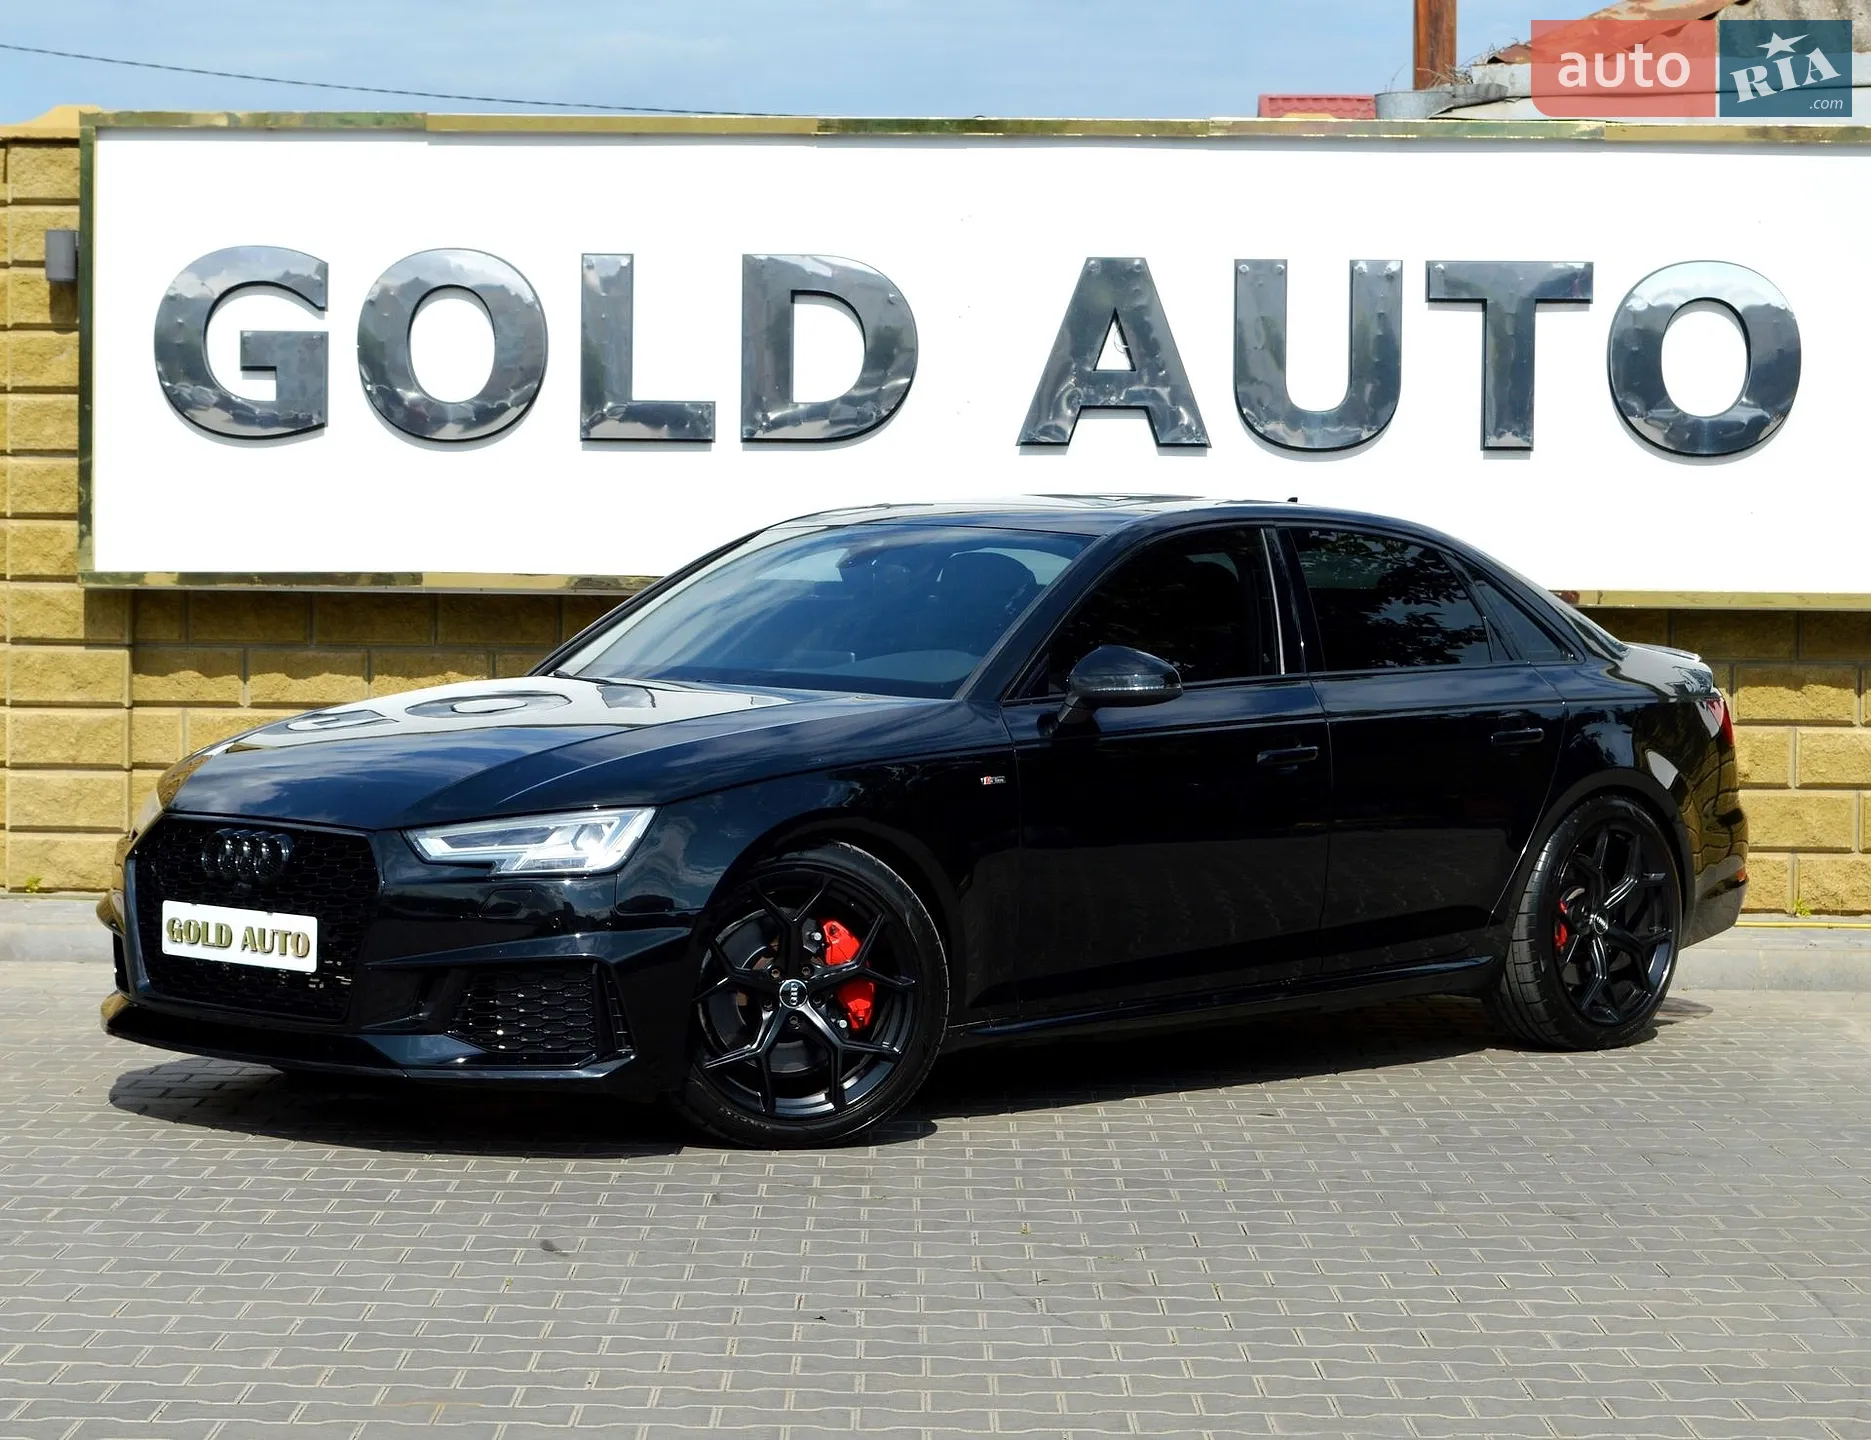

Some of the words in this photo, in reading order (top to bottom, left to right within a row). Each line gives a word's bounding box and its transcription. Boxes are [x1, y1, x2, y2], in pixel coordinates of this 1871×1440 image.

[153, 245, 918, 443] GOLD
[1016, 256, 1802, 456] AUTO
[166, 916, 233, 949] GOLD
[241, 926, 311, 959] AUTO
